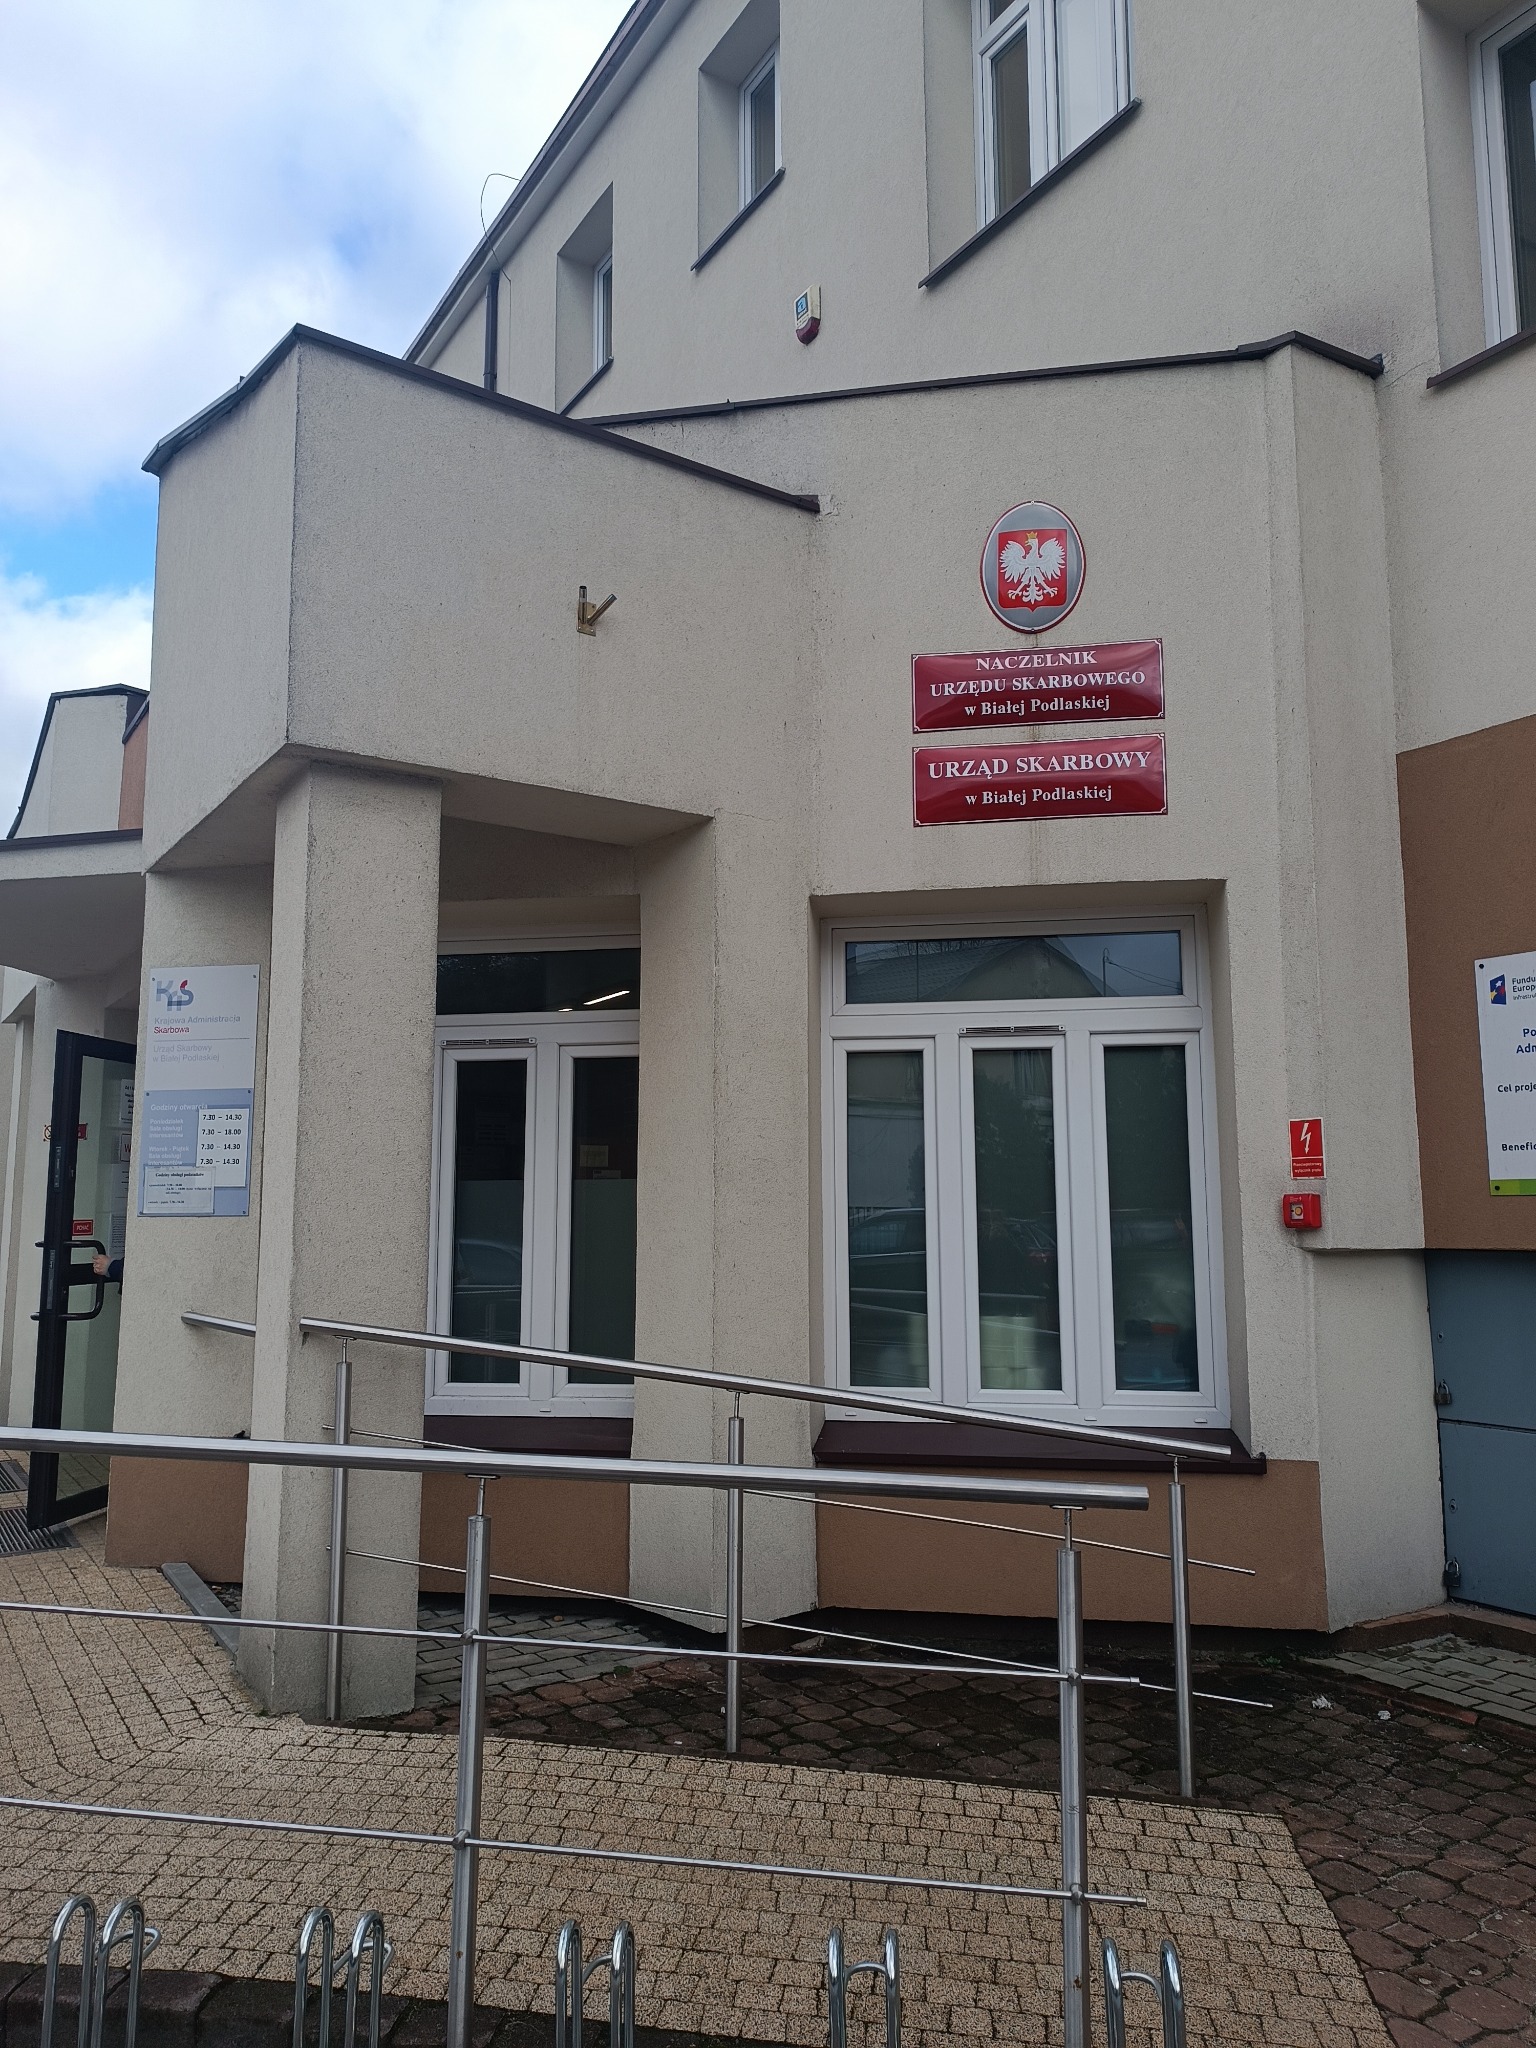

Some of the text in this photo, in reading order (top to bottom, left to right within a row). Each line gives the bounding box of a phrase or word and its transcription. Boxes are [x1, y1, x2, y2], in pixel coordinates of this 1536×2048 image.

[976, 651, 1097, 671] NACZELNIK
[930, 671, 1145, 697] URZĘDU SKARBOWEGO
[964, 695, 1110, 716] w Białej Podlaskiej
[928, 751, 1151, 779] URZĄD SKARBOWY
[965, 785, 1112, 806] w Białej Podlaskiej
[154, 1014, 241, 1026] Krajowa Administracja
[153, 1026, 190, 1034] Skarbowa
[153, 1044, 212, 1054] Urząd Skarbowy
[182, 1052, 220, 1062] Podlaskiej
[1497, 1083, 1512, 1093] Cel
[150, 1103, 178, 1112] Godziny
[200, 1143, 215, 1151] 7.30
